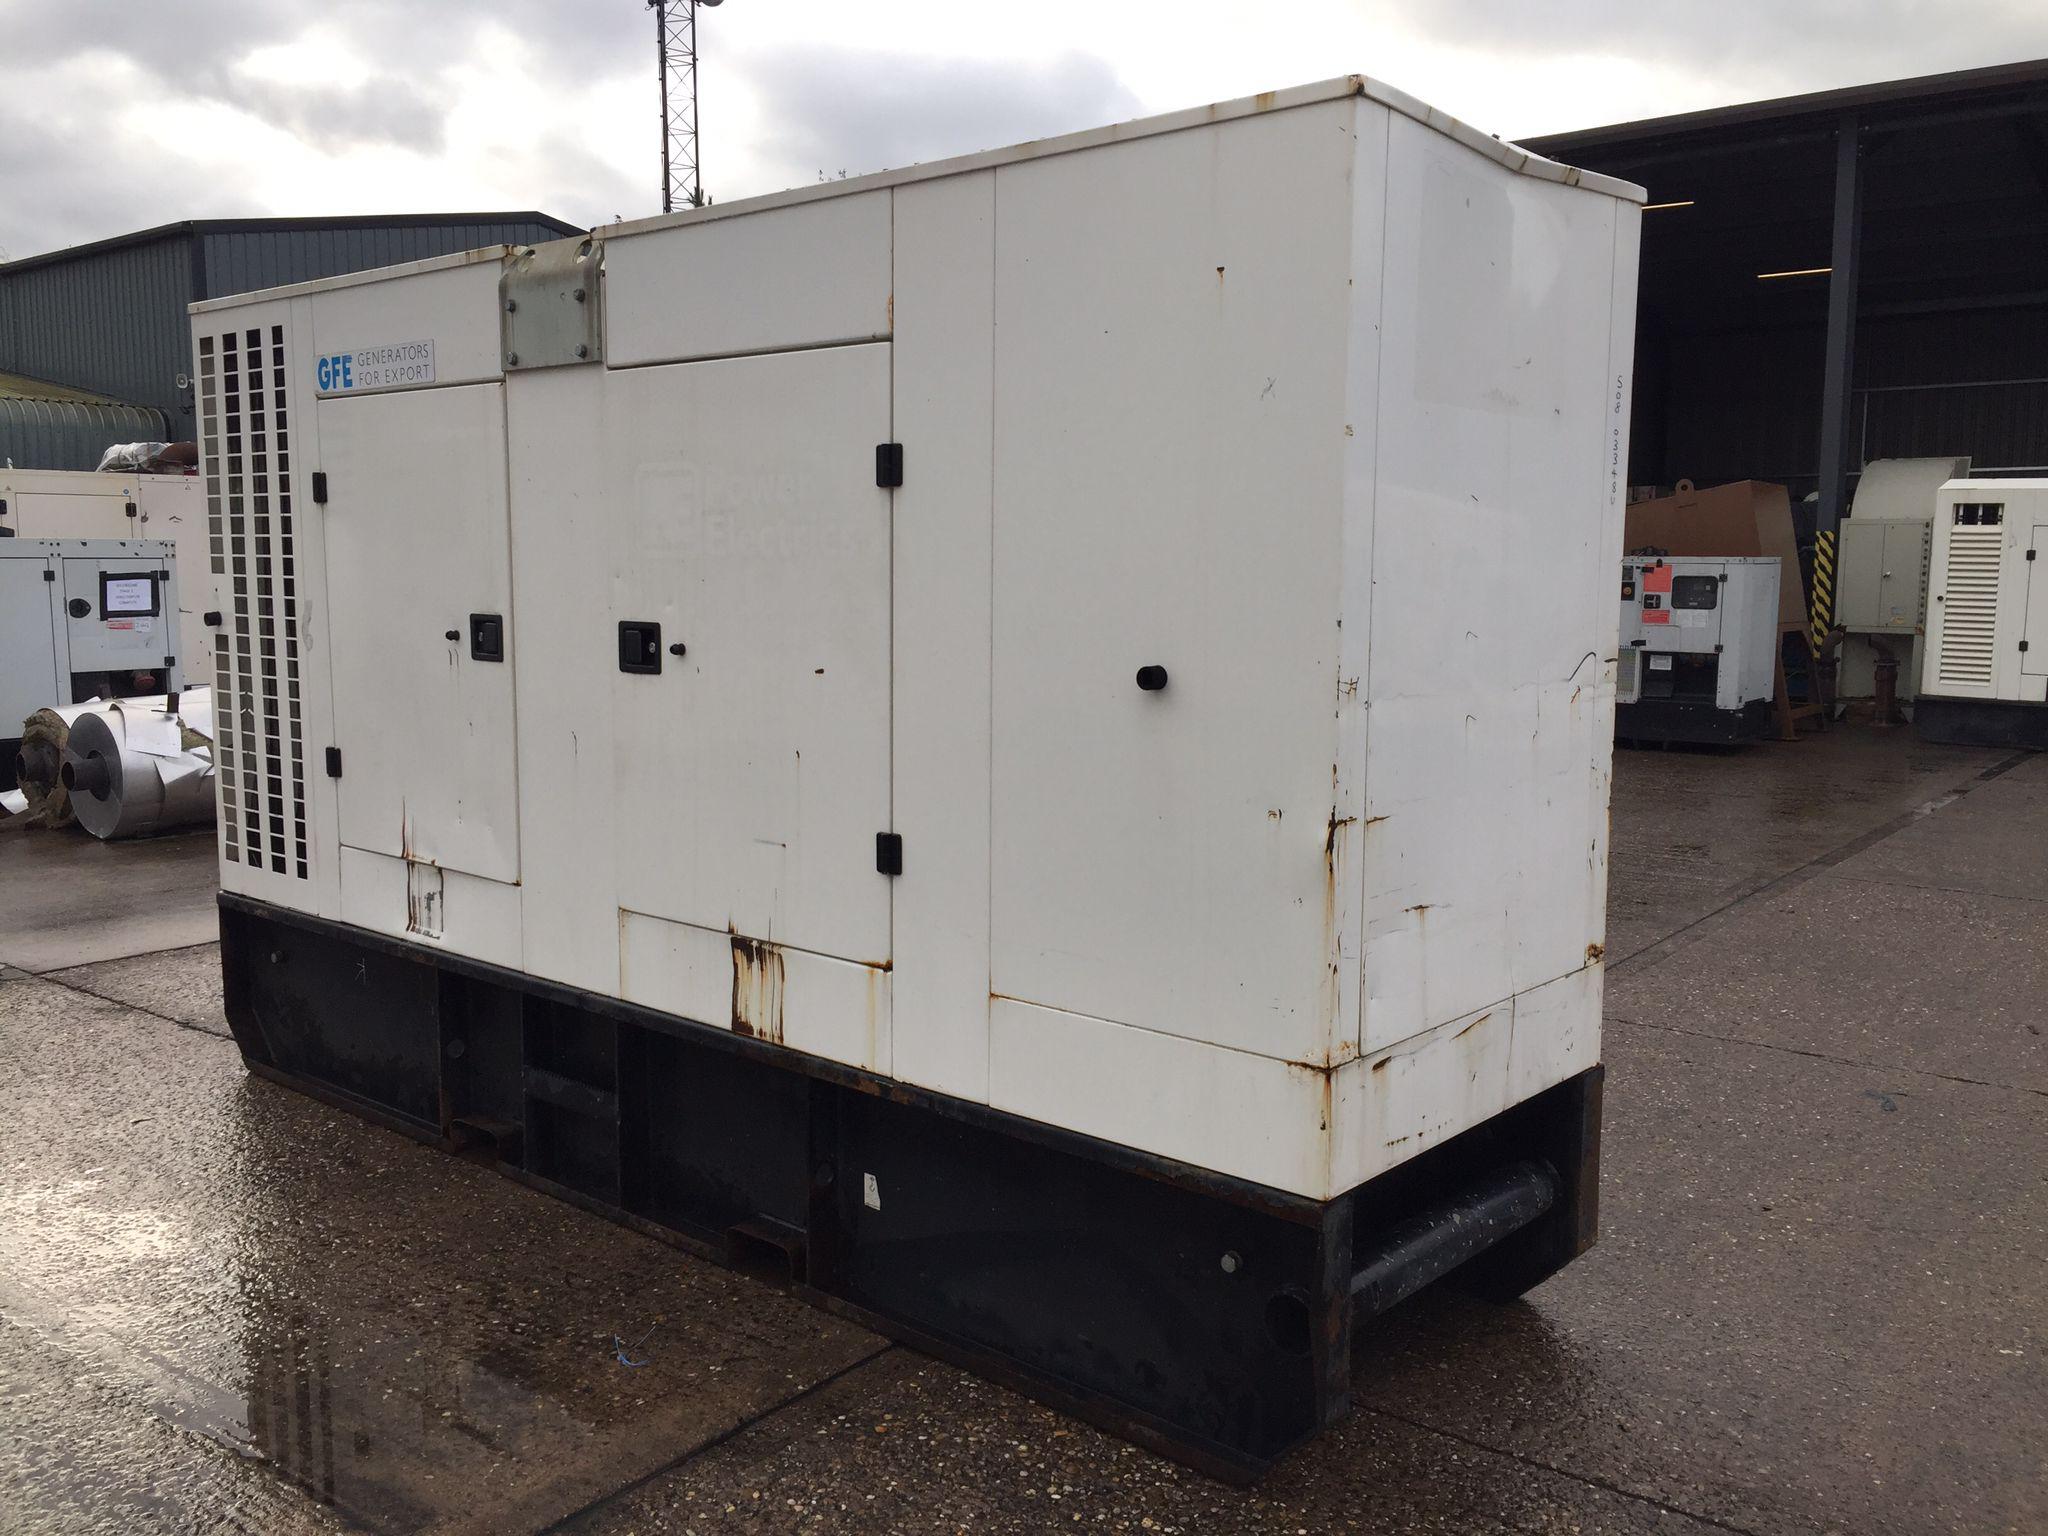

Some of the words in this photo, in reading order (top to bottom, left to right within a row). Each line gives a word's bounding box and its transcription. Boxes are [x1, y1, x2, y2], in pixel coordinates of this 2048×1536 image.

[357, 343, 429, 367] GENERATORS
[318, 354, 353, 391] GFE
[359, 370, 381, 386] FOR
[385, 364, 430, 384] EXPORT
